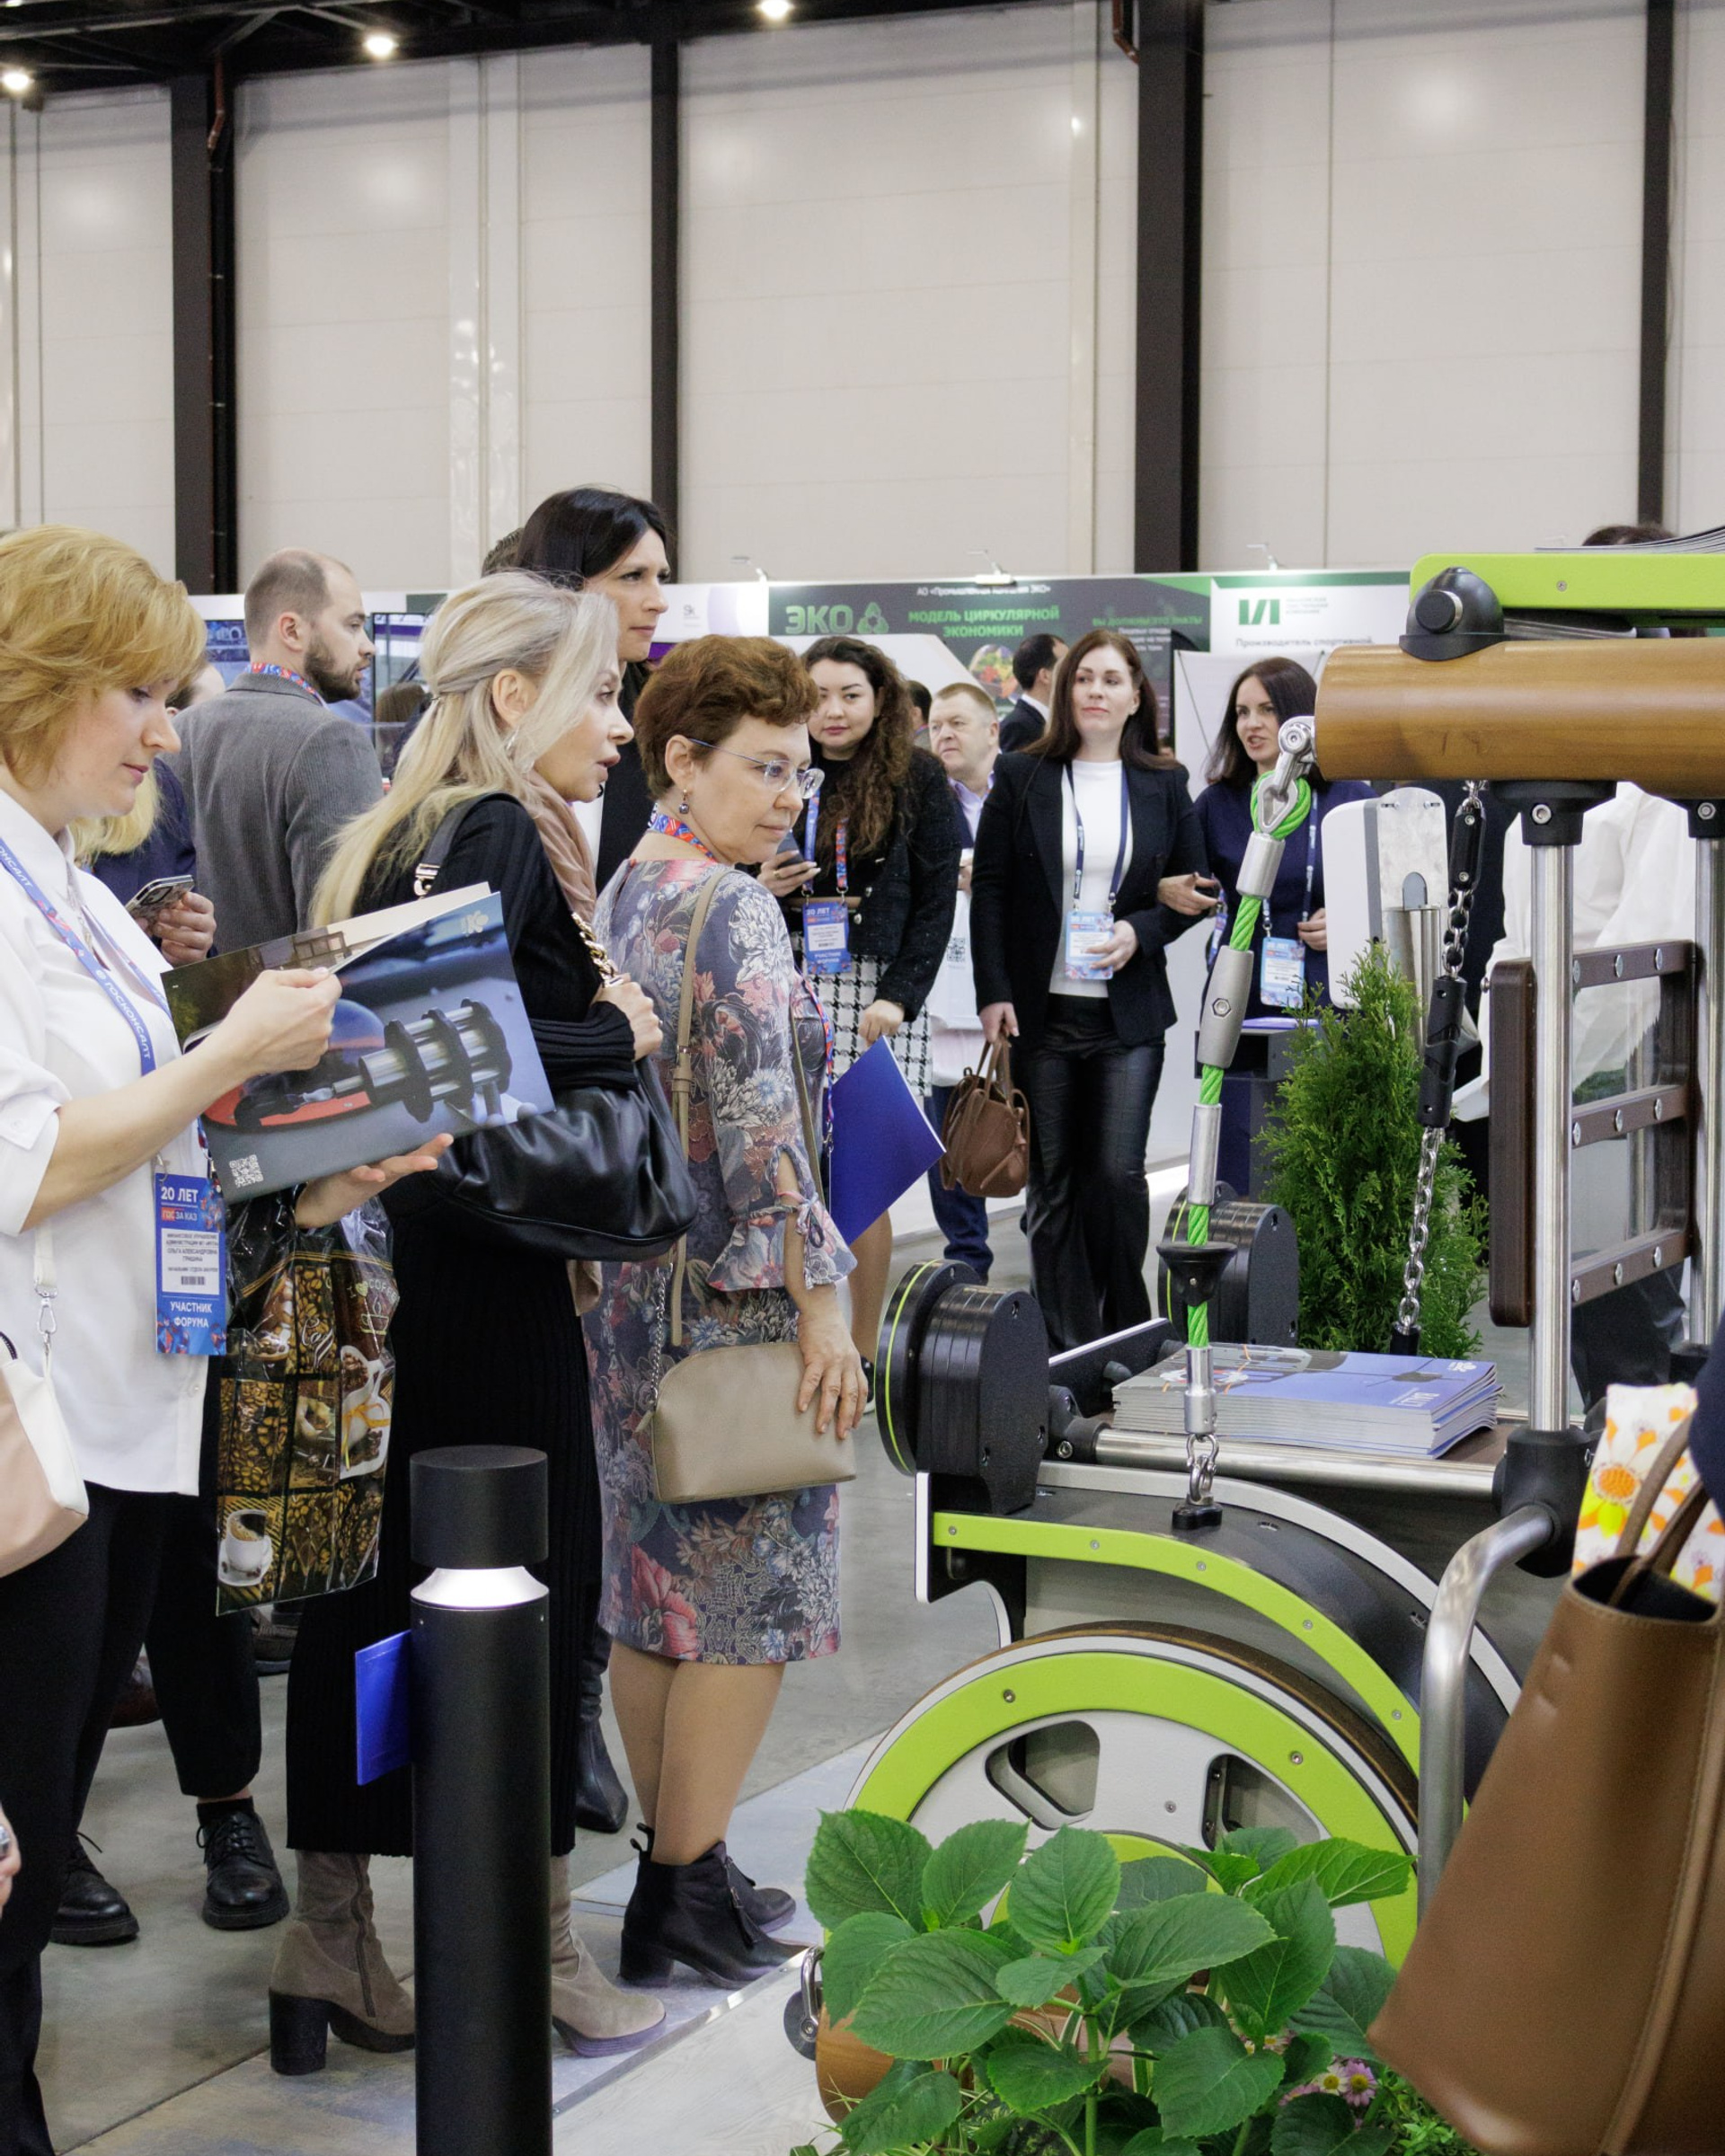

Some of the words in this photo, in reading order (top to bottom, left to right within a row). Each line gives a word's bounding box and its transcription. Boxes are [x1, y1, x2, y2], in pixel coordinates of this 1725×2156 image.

[785, 605, 854, 634] ЭКО
[908, 611, 961, 623] МОДЕЛЬ
[963, 605, 1060, 623] ЦИРКУЛЯРНОЙ
[944, 625, 1024, 638] ЭКОНОМИКИ
[1236, 638, 1312, 648] Производитель
[104, 982, 151, 1059] ГОСКОНСАЛТ
[161, 1186, 175, 1201] 20
[177, 1188, 199, 1203] ЛЕТ
[170, 1301, 213, 1313] УЧАСТНИК
[173, 1316, 209, 1329] ФОРУМА
